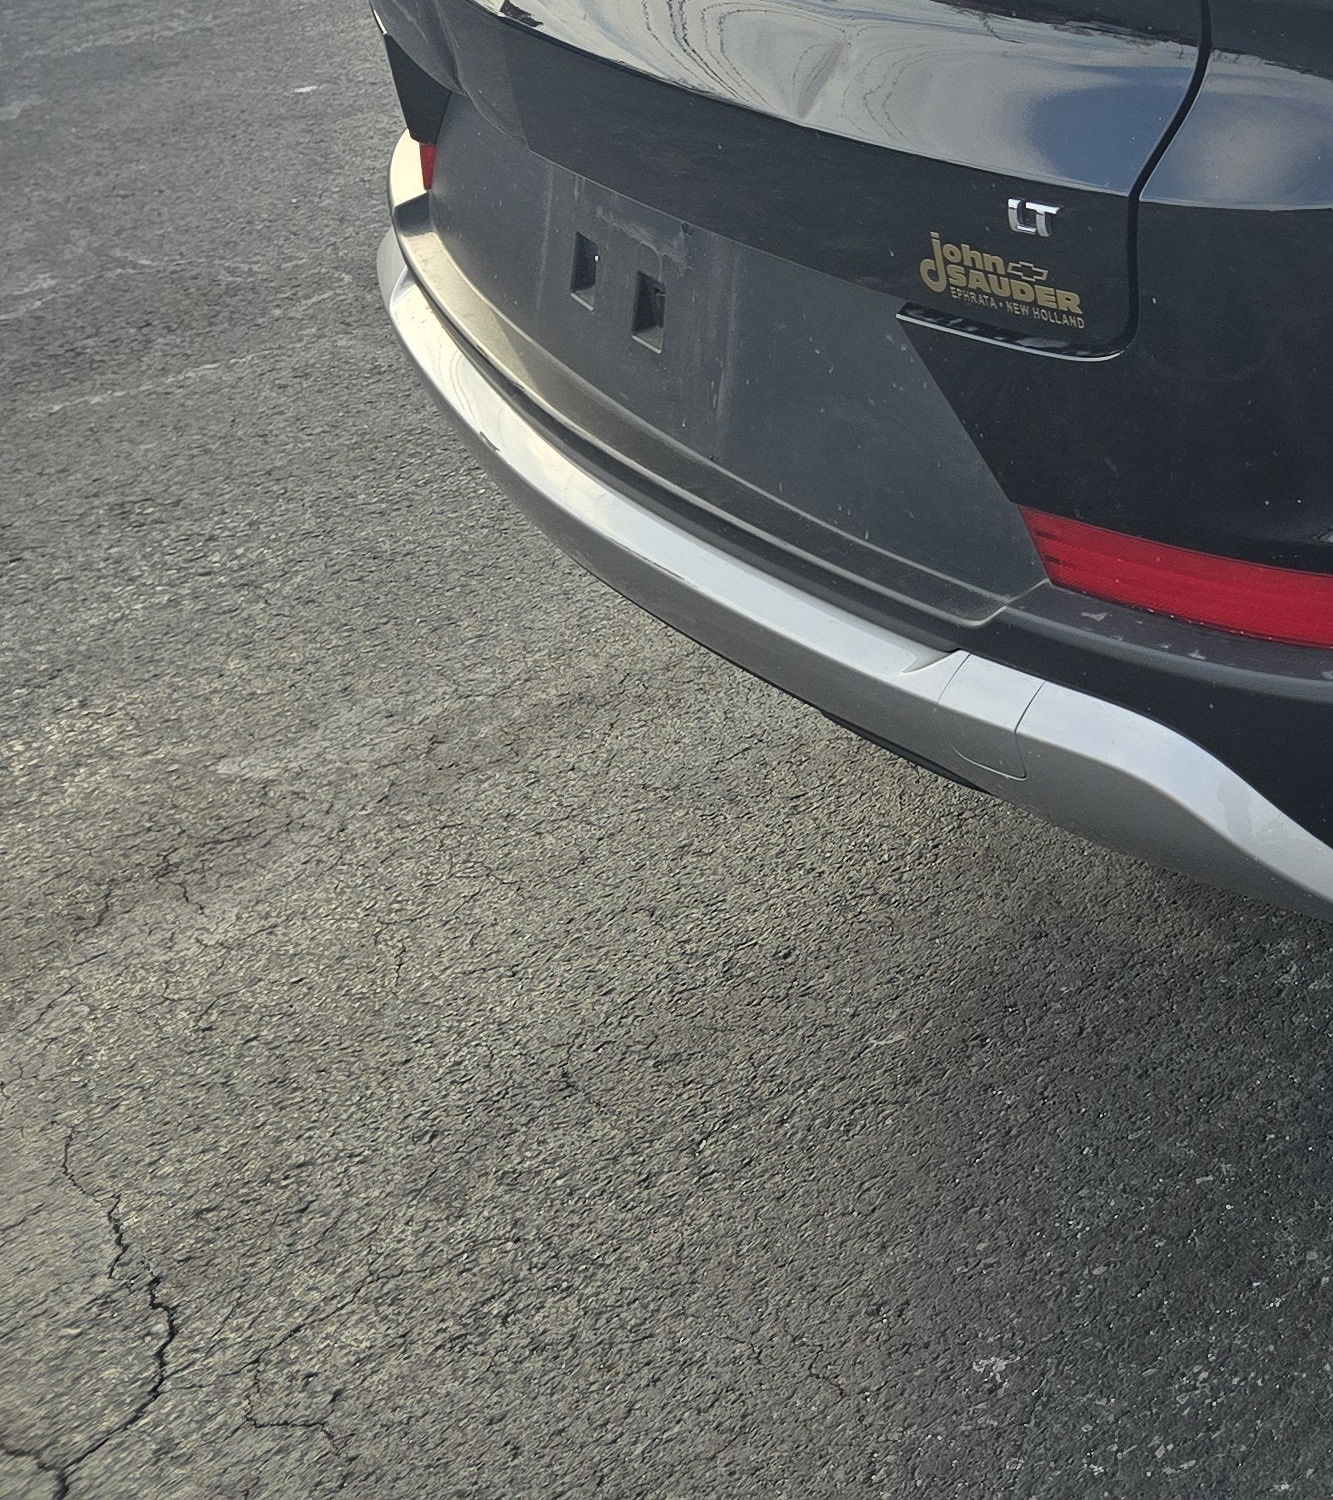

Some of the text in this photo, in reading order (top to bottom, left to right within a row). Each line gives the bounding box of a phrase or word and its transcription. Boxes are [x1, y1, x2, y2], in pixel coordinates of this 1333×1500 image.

[1008, 199, 1061, 237] LT
[920, 231, 1006, 293] john
[947, 265, 1083, 315] SAUDER
[950, 286, 1085, 330] EPHRATA NEW HOLLAND
